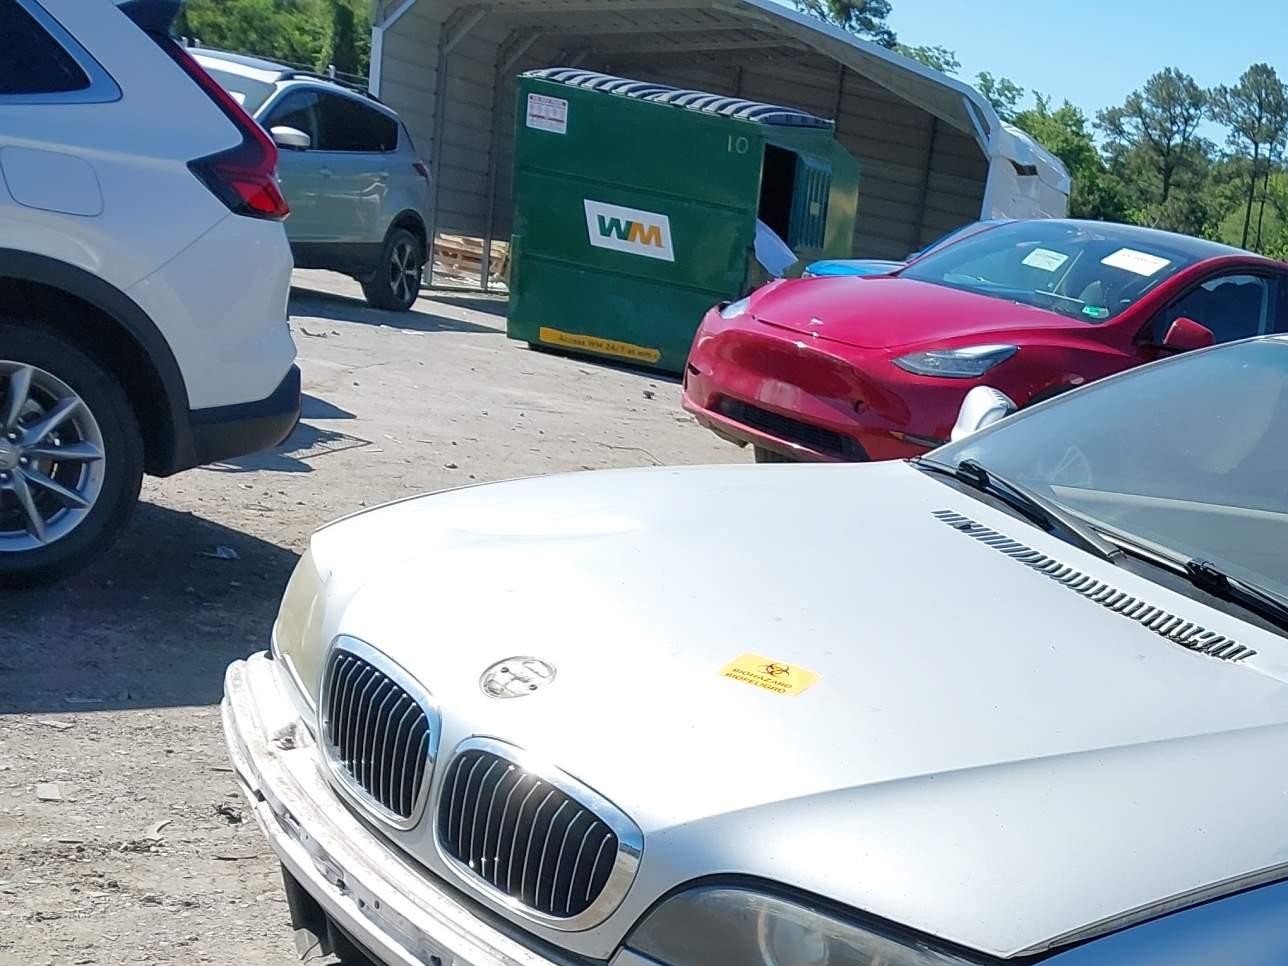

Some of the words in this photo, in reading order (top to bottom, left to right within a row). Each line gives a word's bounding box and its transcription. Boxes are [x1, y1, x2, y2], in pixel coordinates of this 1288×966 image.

[728, 135, 749, 154] 10
[597, 213, 664, 249] WM
[725, 672, 786, 694] BIOPELIGRO
[732, 667, 793, 689] BIOHAZARD
